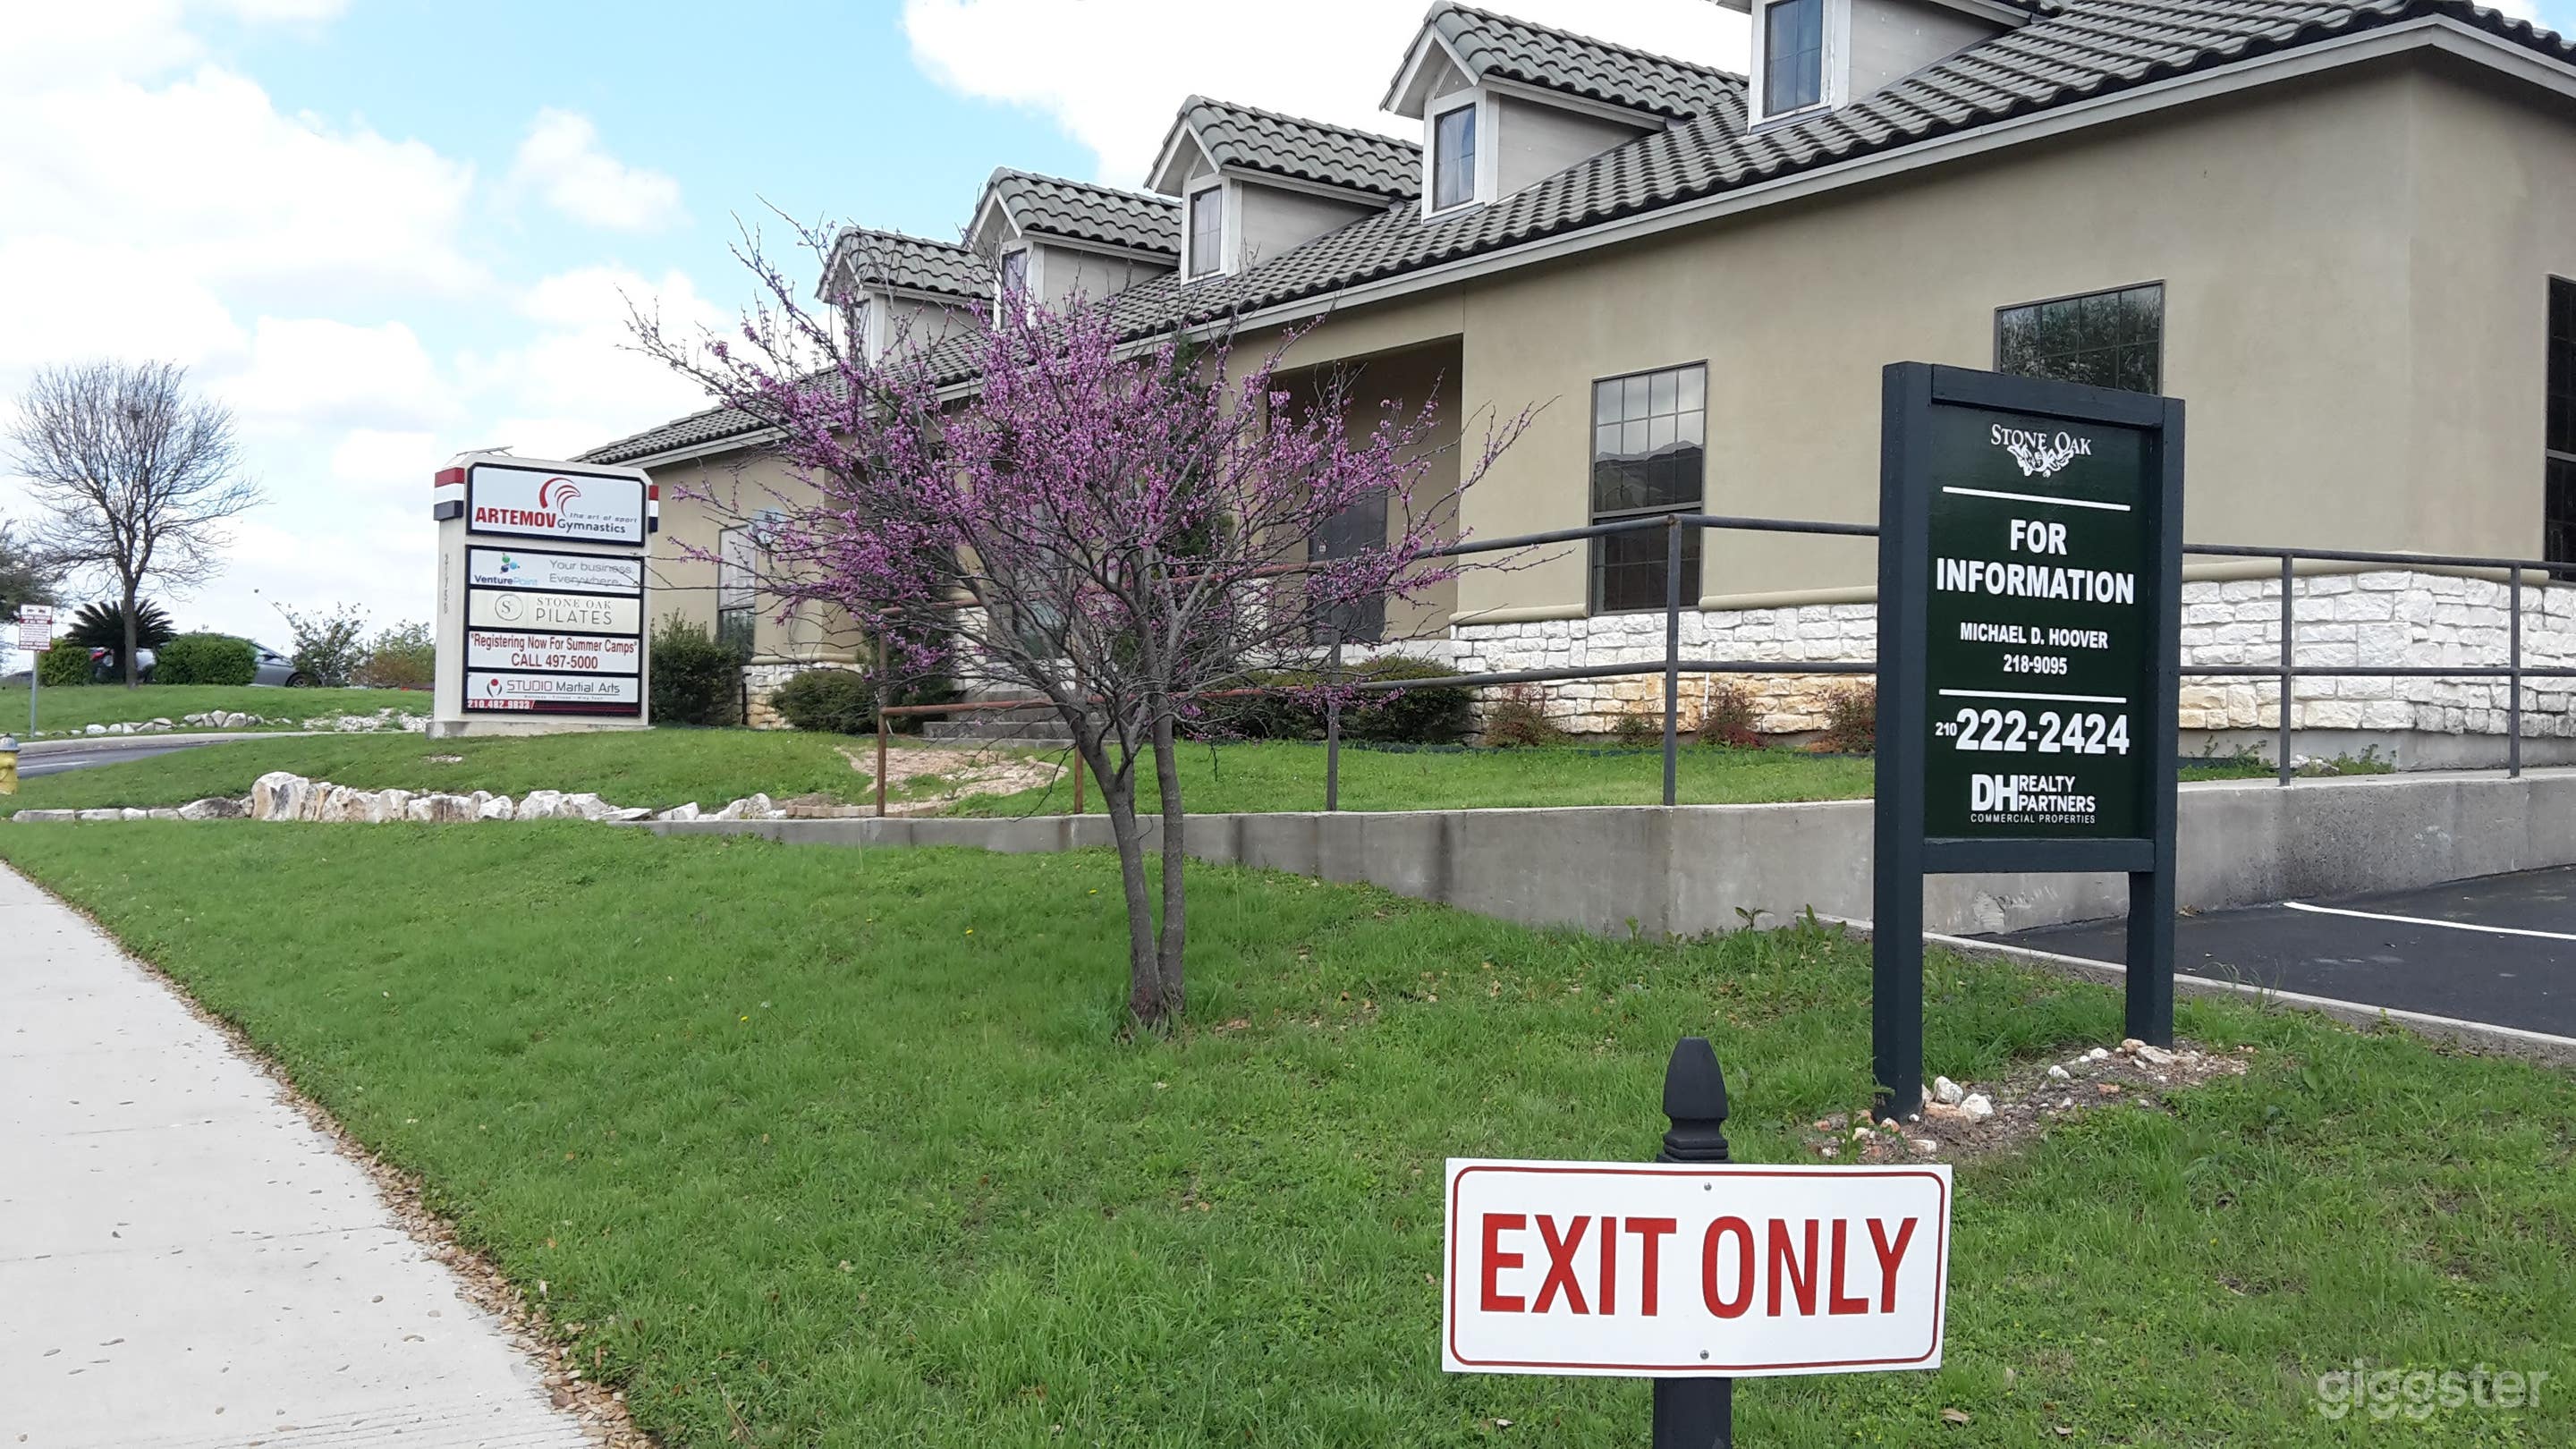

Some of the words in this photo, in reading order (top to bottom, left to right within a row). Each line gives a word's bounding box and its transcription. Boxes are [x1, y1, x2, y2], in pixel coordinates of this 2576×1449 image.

[1990, 424, 2047, 449] STONE
[2055, 431, 2092, 456] OAK
[475, 506, 557, 529] ARTEMOV
[557, 519, 626, 534] Gymnastics
[2010, 519, 2068, 555] FOR
[549, 559, 576, 571] Your
[1936, 557, 2134, 605] INFORMATION
[537, 597, 580, 608] STONE
[586, 599, 612, 610] OAK
[536, 608, 613, 625] PILATES
[528, 636, 547, 649] Now
[549, 637, 564, 649] For
[566, 638, 603, 652] Summer
[1960, 622, 2027, 645] MICHAEL
[2031, 627, 2045, 645] D.
[2049, 628, 2108, 649] HOOVER
[511, 653, 542, 667] CALL
[546, 654, 598, 669] 497-5000
[2003, 654, 2067, 674] 218-9095
[506, 680, 553, 692] STUDIO
[555, 682, 594, 693] Martial
[598, 682, 621, 694] Arts
[1935, 722, 1957, 736] 210
[1955, 708, 2130, 755] 222-2424
[1971, 774, 2019, 811] DH
[2019, 775, 2075, 793] REALTY
[2018, 794, 2096, 812] PARTNERS
[1970, 813, 2035, 823] COMMERCIAL
[2039, 815, 2096, 824] PROPERTIES
[1480, 1213, 1677, 1317] EXIT
[1701, 1216, 1919, 1319] ONLY
